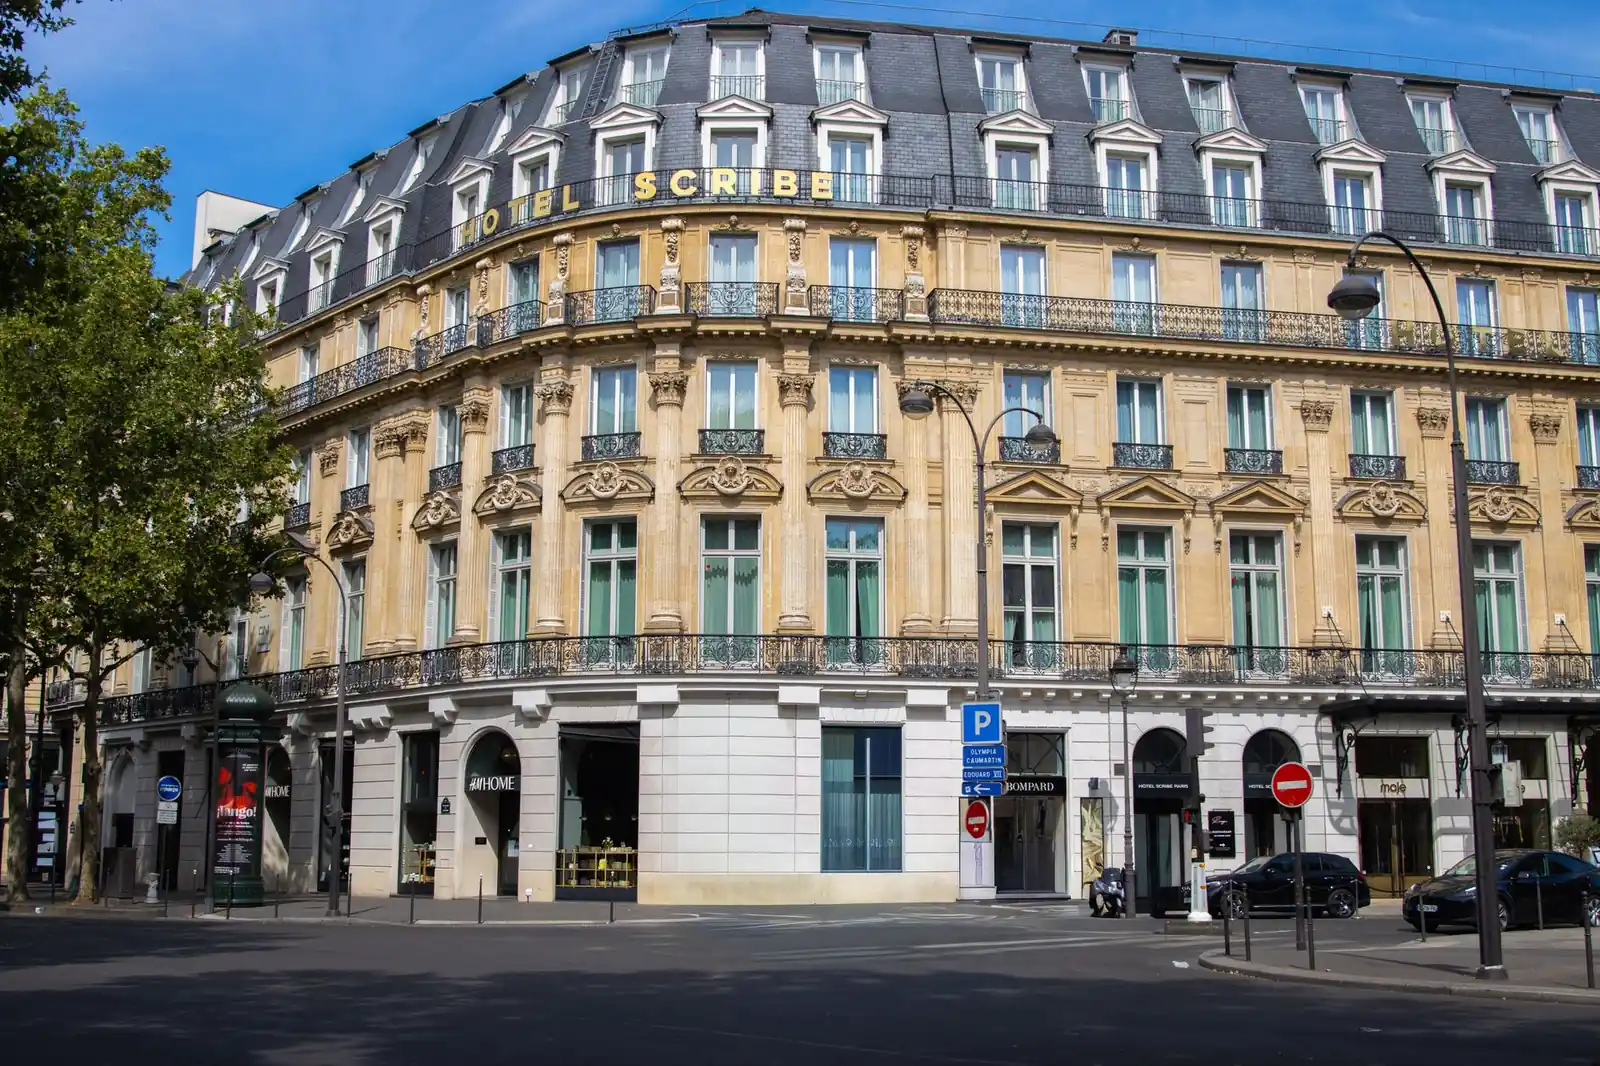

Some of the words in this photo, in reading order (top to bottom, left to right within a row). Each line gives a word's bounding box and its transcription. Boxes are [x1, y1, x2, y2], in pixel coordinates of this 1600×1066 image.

[460, 185, 580, 246] HOTEL
[634, 168, 833, 200] SCRIBE
[974, 711, 991, 736] P
[993, 770, 1002, 778] VII
[483, 776, 515, 791] HOME
[1007, 782, 1054, 791] BOMPARD
[1380, 782, 1407, 794] maje
[271, 785, 290, 798] HOME
